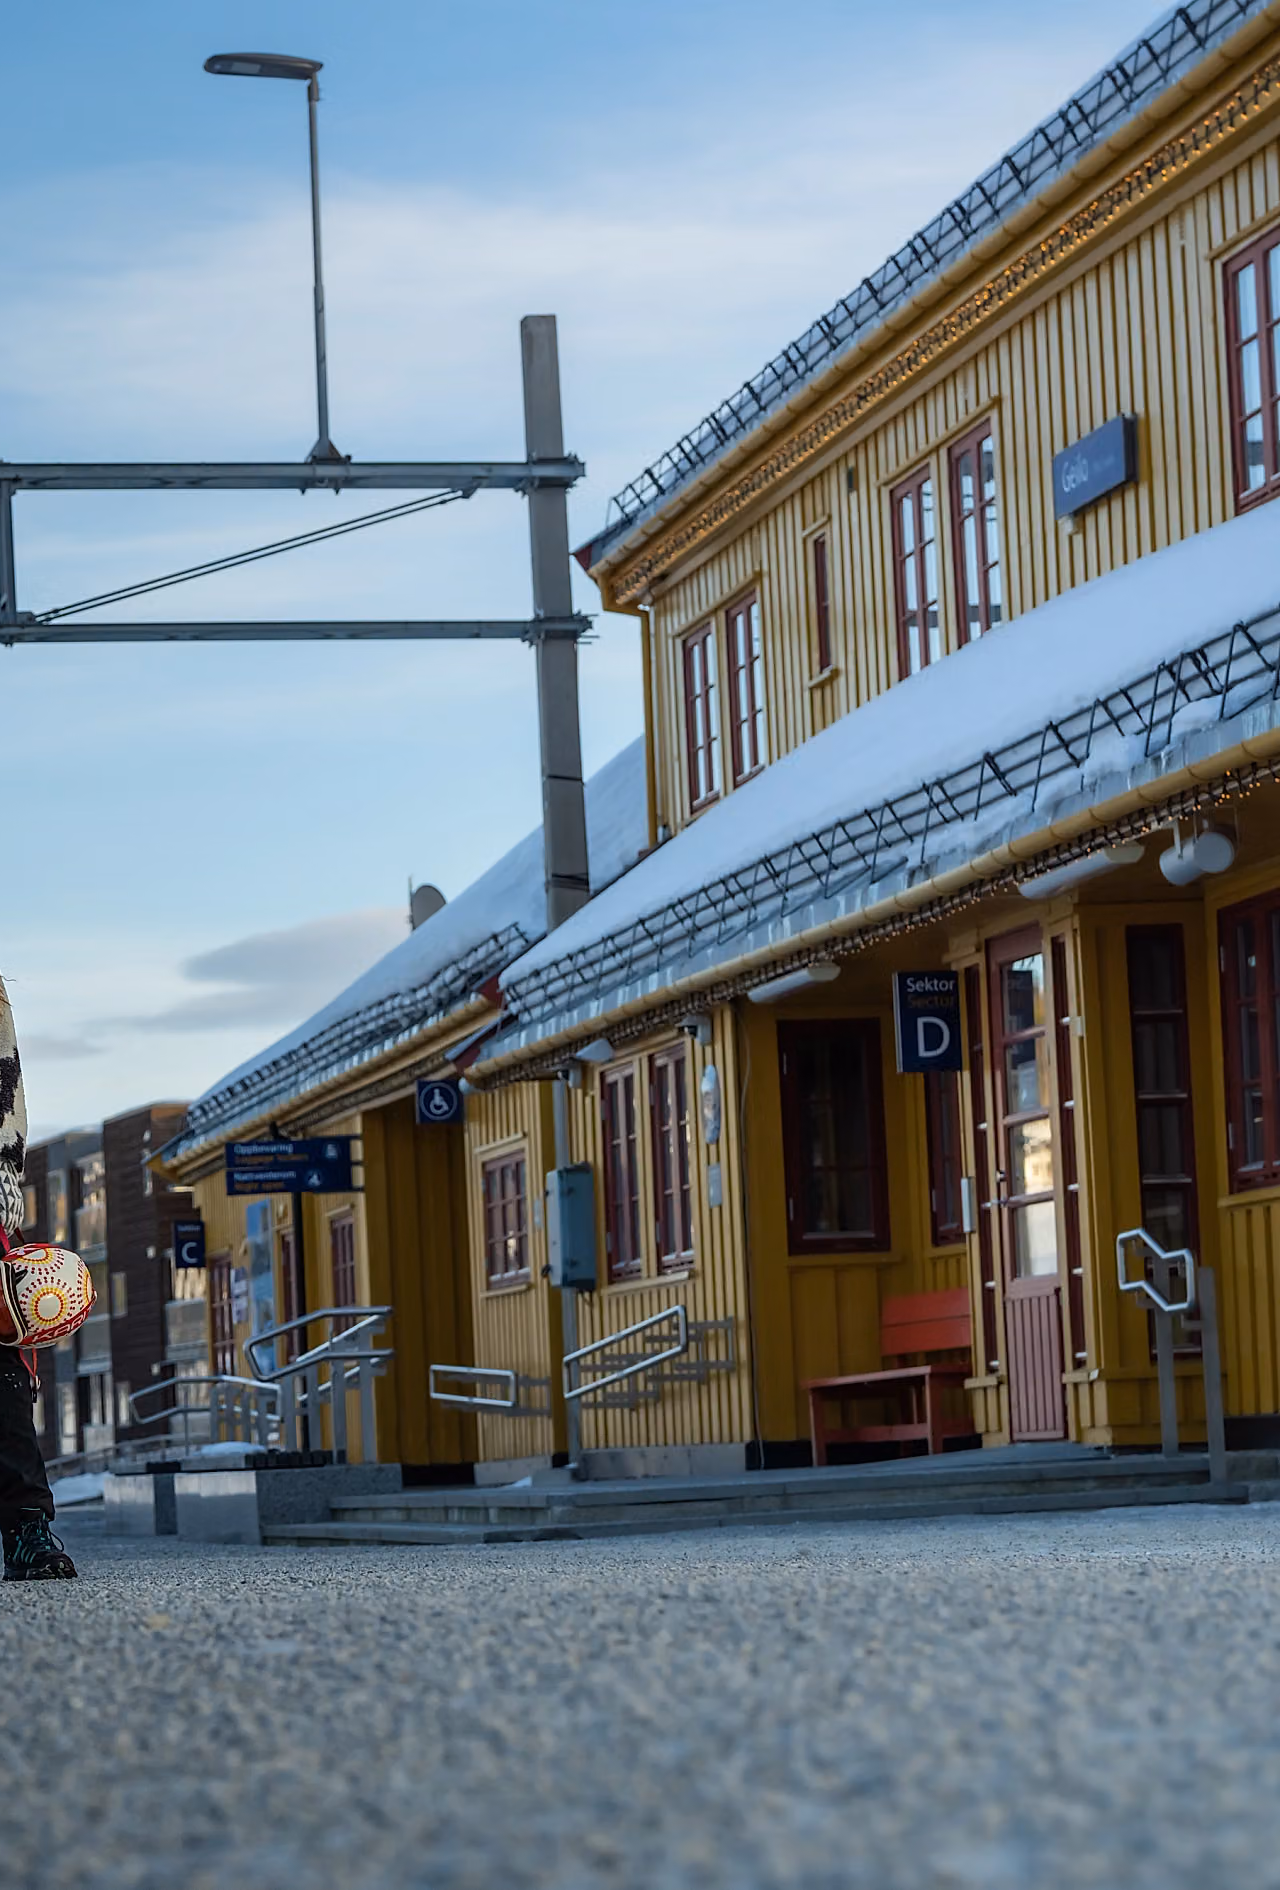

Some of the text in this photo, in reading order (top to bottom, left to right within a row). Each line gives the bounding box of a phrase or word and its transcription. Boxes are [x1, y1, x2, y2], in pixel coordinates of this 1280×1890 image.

[906, 977, 955, 992] Sektor
[916, 1016, 950, 1058] D
[181, 1242, 198, 1264] C
[31, 1311, 87, 1343] KARI
